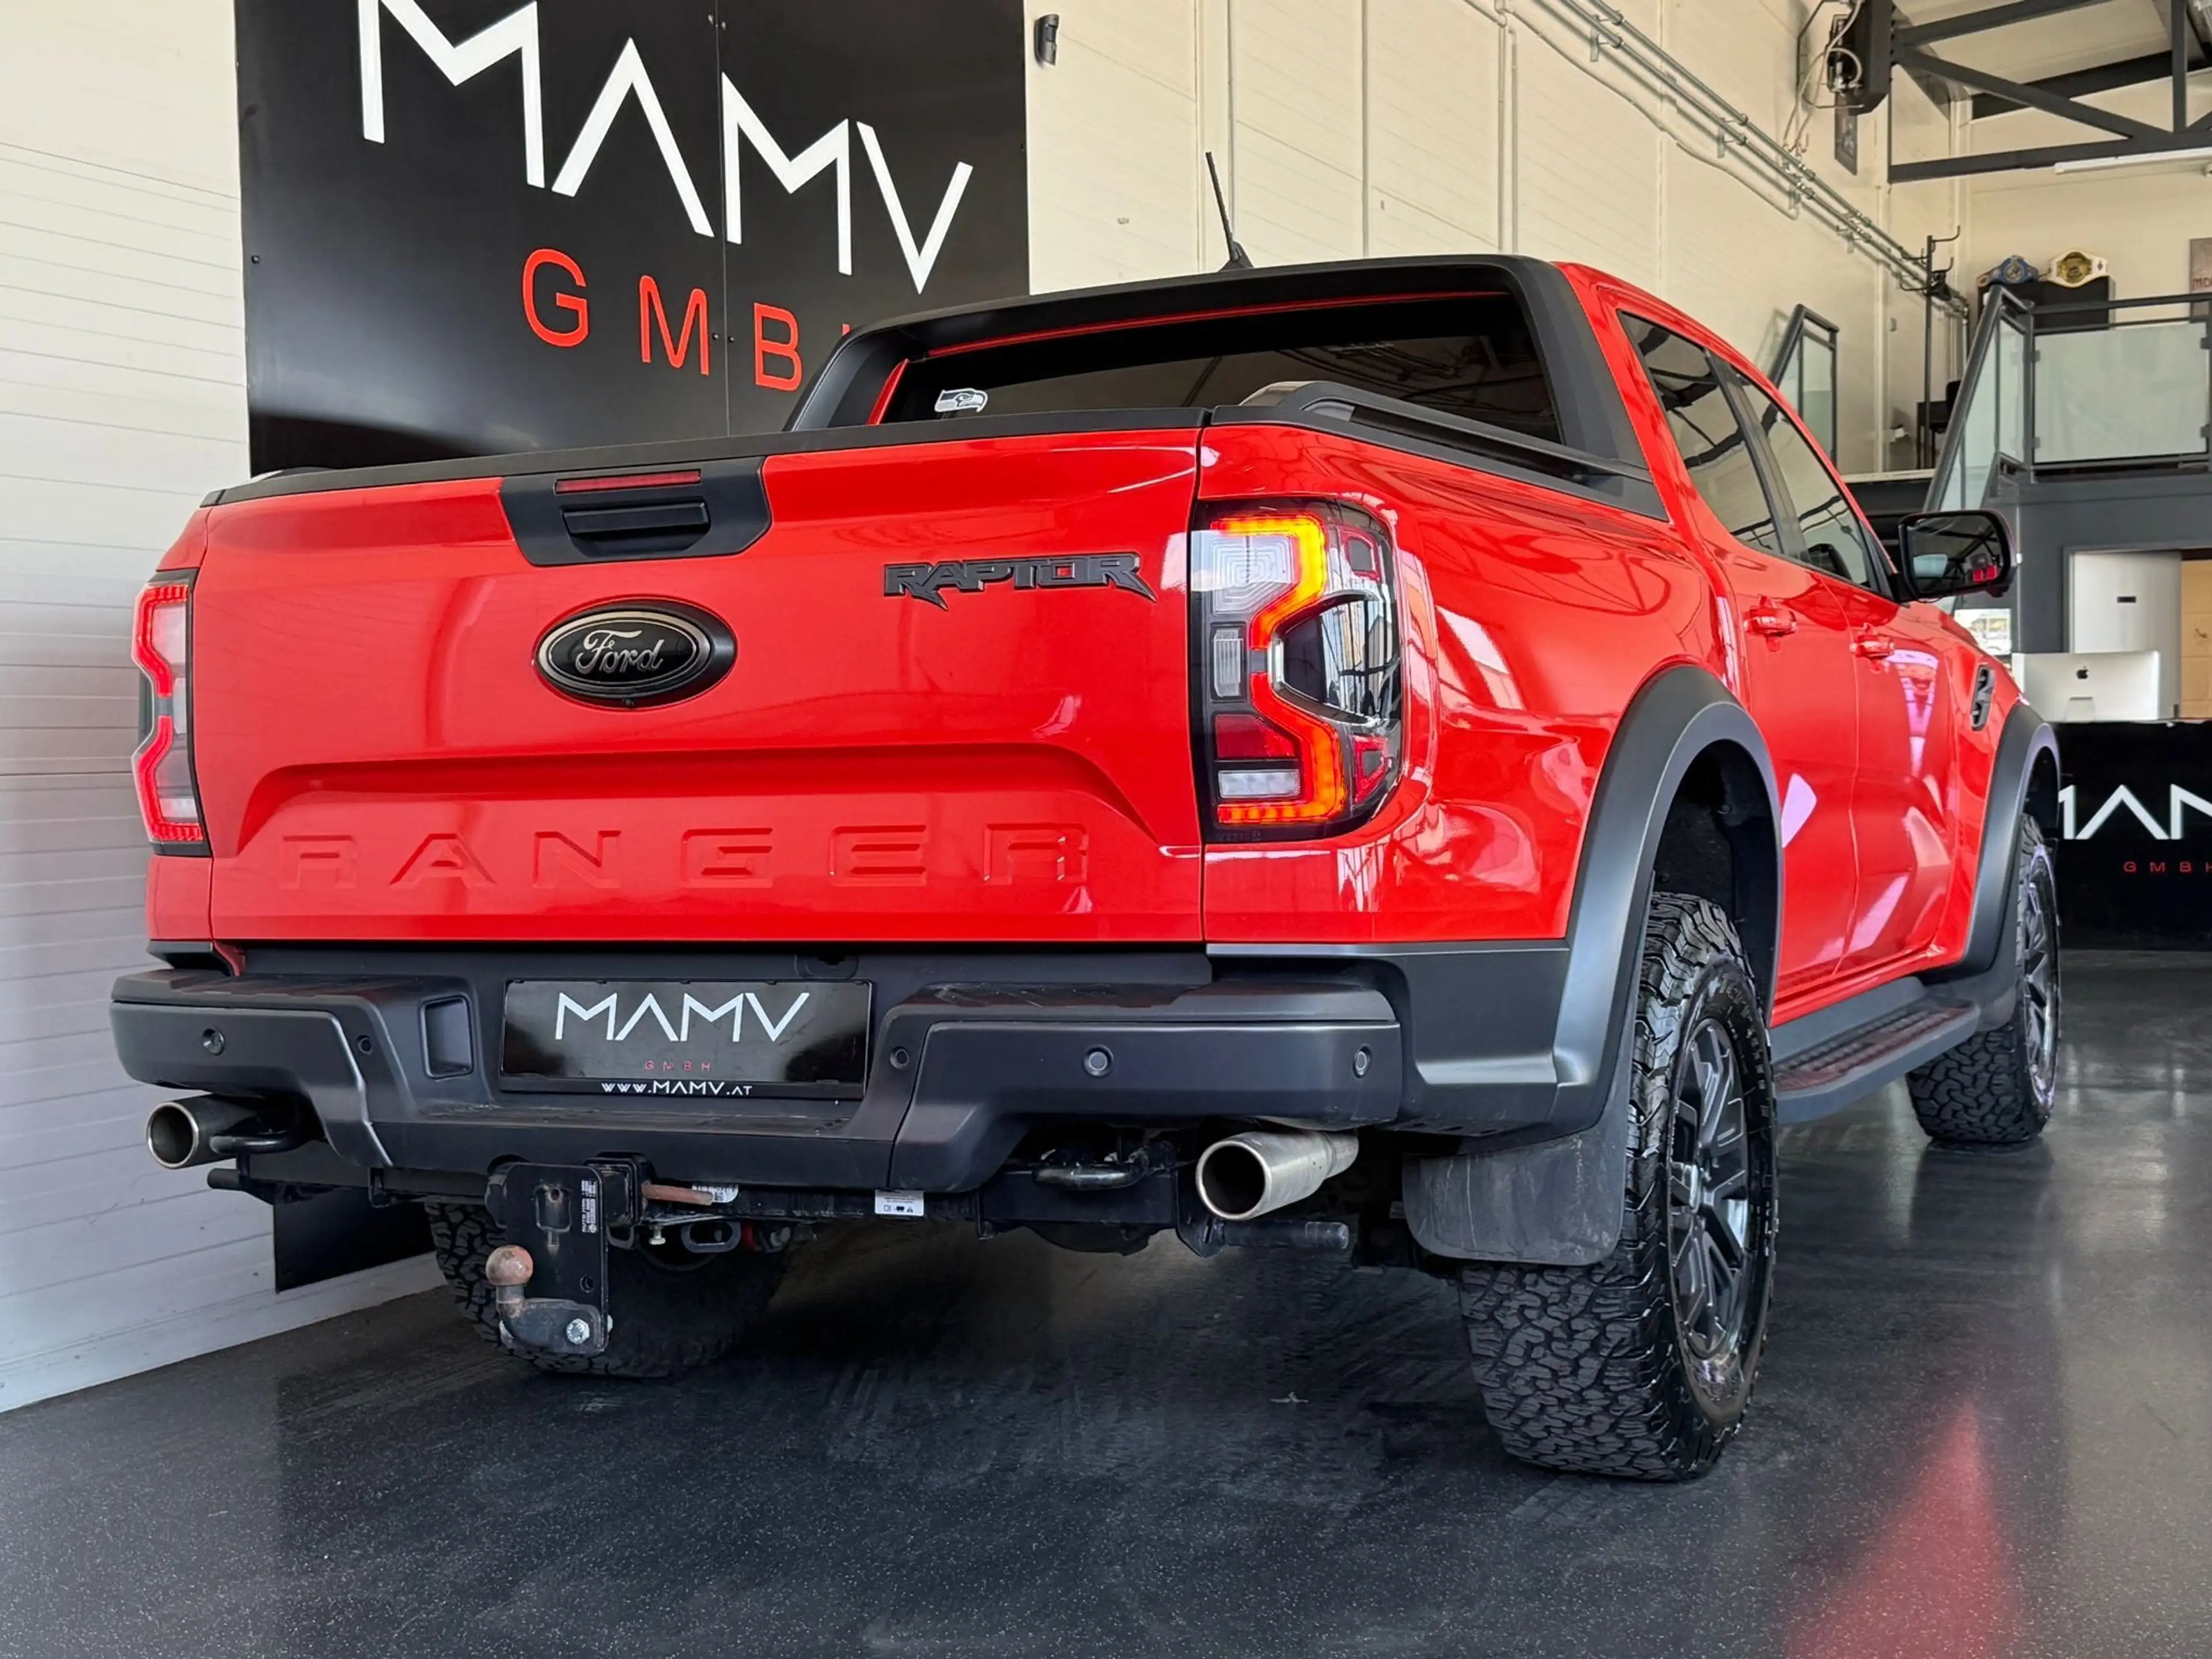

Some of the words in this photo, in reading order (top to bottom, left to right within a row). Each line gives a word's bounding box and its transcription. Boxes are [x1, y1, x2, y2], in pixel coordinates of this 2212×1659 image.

[358, 0, 974, 294] MAMV
[522, 248, 851, 392] GMB
[884, 551, 1158, 612] RAPTOR
[575, 629, 665, 675] Ford
[278, 821, 1090, 891] RANGER
[555, 991, 810, 1042] MAMV
[644, 1060, 711, 1073] GMBH
